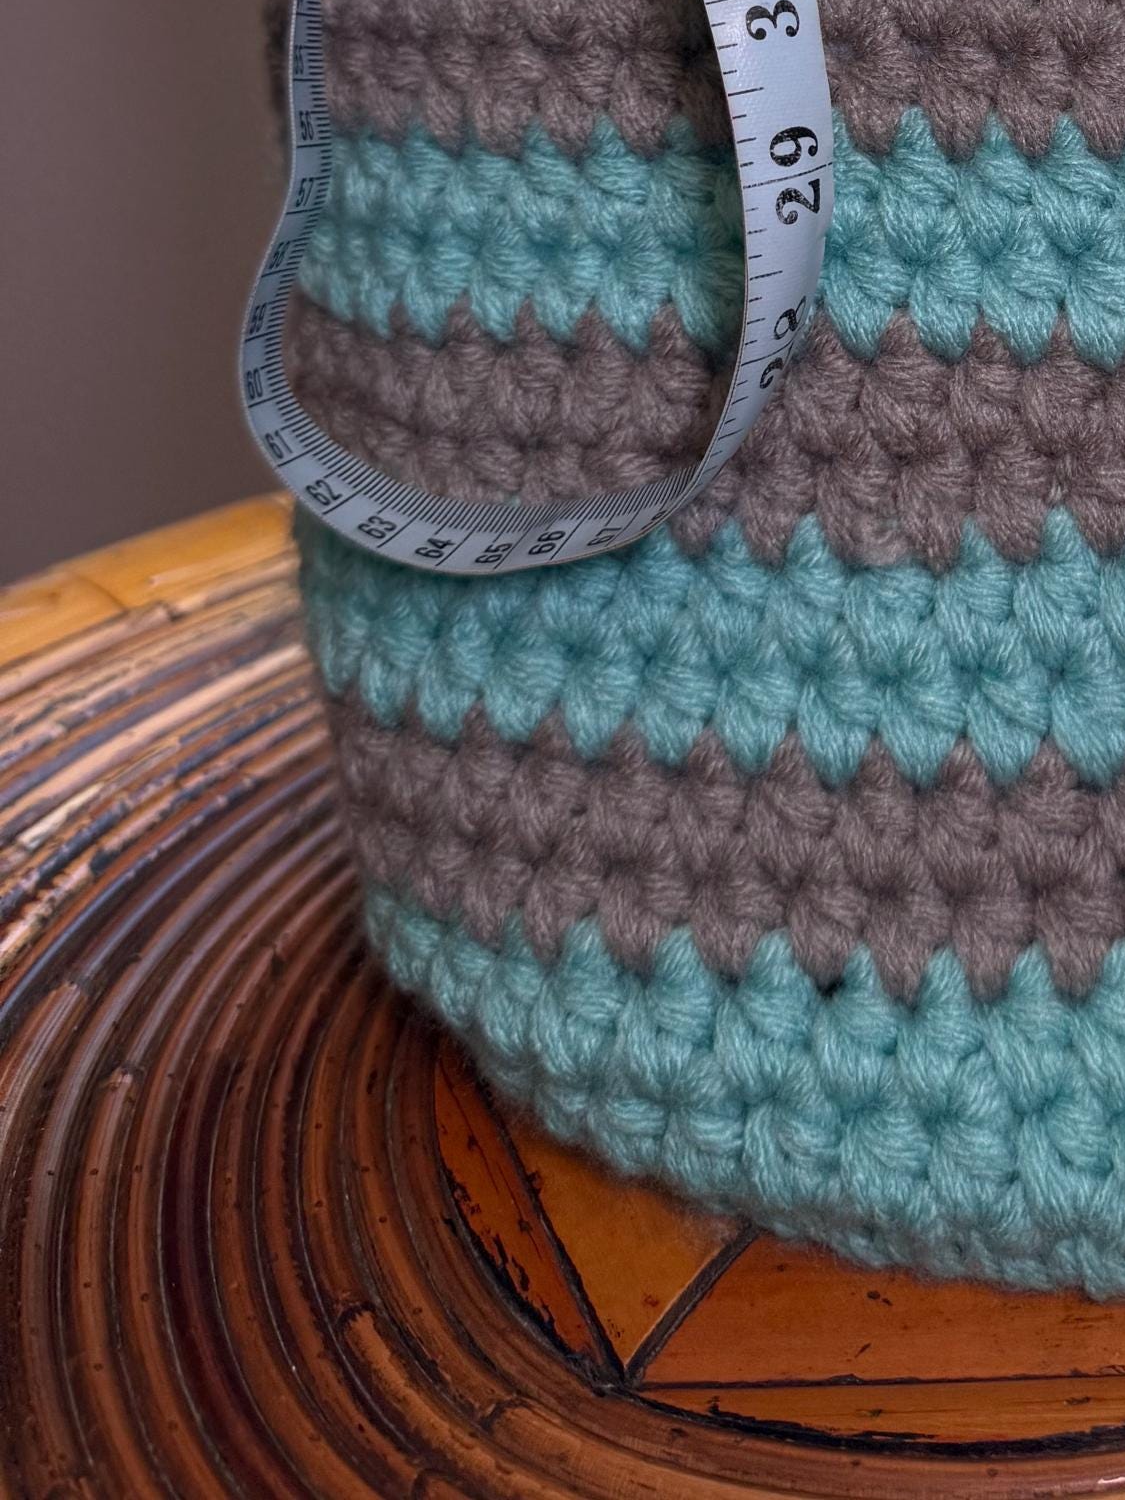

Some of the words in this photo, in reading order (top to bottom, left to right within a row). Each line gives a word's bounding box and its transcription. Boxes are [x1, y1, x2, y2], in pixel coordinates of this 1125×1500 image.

[299, 110, 314, 141] 56
[769, 125, 821, 225] 29
[295, 177, 314, 208] 57
[246, 368, 263, 400] 60
[264, 430, 293, 461] 61
[305, 478, 343, 507] 62
[358, 514, 398, 541] 63
[586, 526, 622, 547] 67
[415, 536, 455, 560] 64
[475, 542, 513, 565] 65
[528, 529, 567, 557] 66
